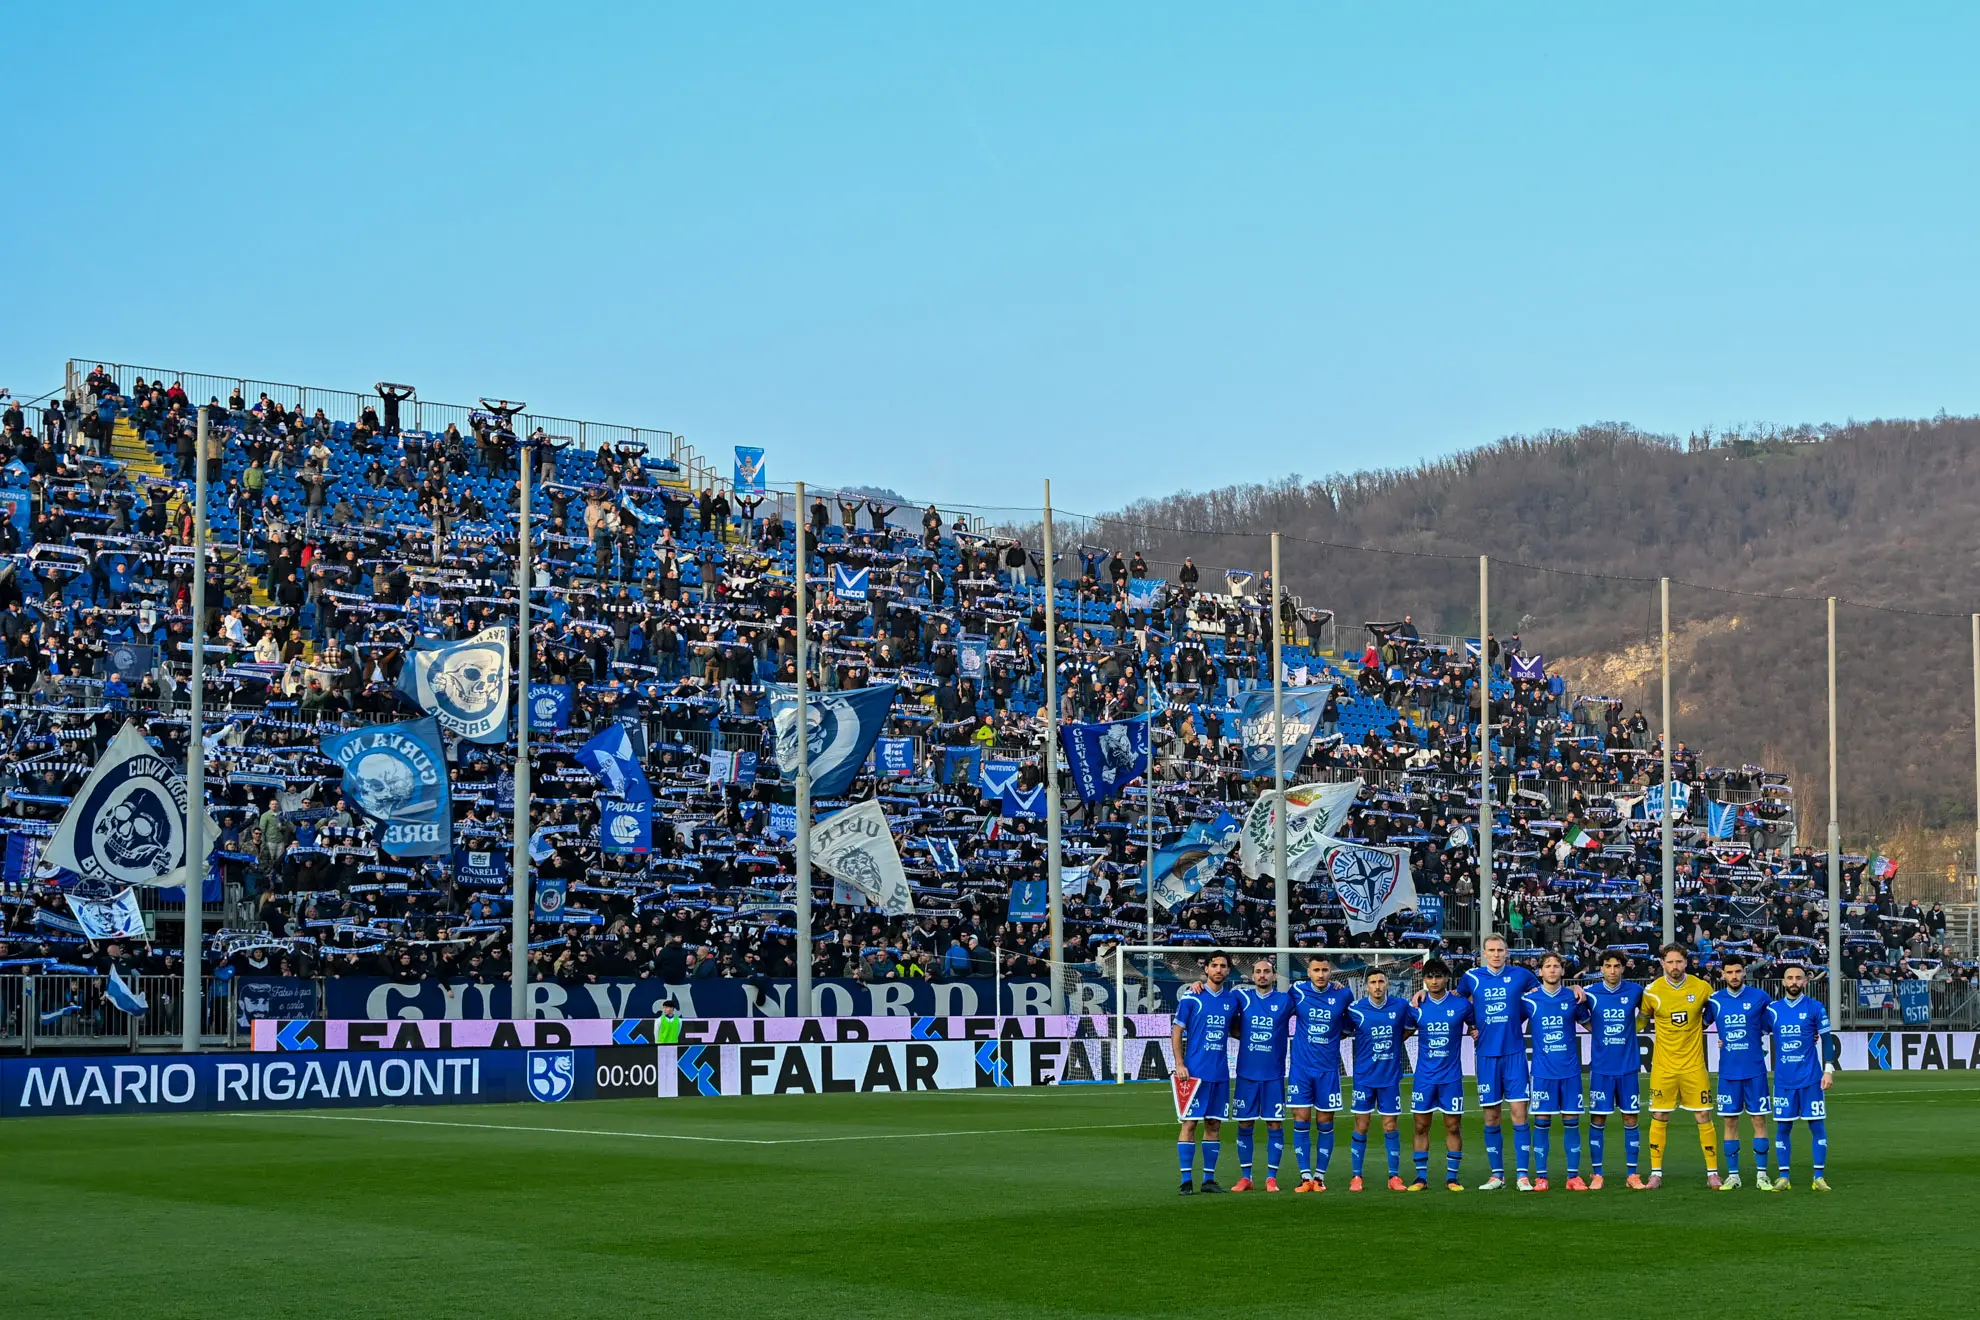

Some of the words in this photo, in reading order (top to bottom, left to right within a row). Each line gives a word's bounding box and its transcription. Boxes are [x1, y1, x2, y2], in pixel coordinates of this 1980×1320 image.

[836, 588, 865, 598] BLOCCO
[129, 757, 167, 781] CURVA
[605, 801, 646, 813] PADILE
[771, 816, 797, 827] PRESE
[457, 875, 504, 885] OFFENDER
[1338, 884, 1369, 913] CURVA
[1484, 987, 1507, 998] a2a
[366, 982, 700, 1020] CURVA
[741, 981, 979, 1017] NORD
[1487, 1003, 1504, 1012] DAC
[1603, 1008, 1625, 1018] a2a
[1308, 1007, 1332, 1020] a2a
[1724, 1013, 1747, 1025] a2a
[1206, 1014, 1226, 1025] a2a
[1251, 1015, 1274, 1027] a2a
[1541, 1015, 1564, 1026] a2a
[1310, 1025, 1326, 1033] DAC
[1371, 1025, 1393, 1037] a2a
[1427, 1021, 1450, 1032] a2a
[1780, 1024, 1801, 1034] a2a
[1208, 1031, 1223, 1039] DAC
[1546, 1033, 1561, 1041] DAC
[1727, 1031, 1744, 1039] DAC
[1375, 1042, 1391, 1050] DAC
[1429, 1039, 1447, 1047] DAC
[1783, 1042, 1799, 1050] DAC
[741, 1043, 939, 1095] FALAR
[1031, 1039, 1189, 1081] FALA
[596, 1064, 657, 1088] 00:00
[20, 1063, 197, 1107] MARIO
[216, 1057, 480, 1102] RIGAMONTI
[1328, 1093, 1342, 1107] 99
[1451, 1097, 1464, 1112] 97
[1274, 1103, 1286, 1118] 2
[1811, 1100, 1825, 1116] 93
